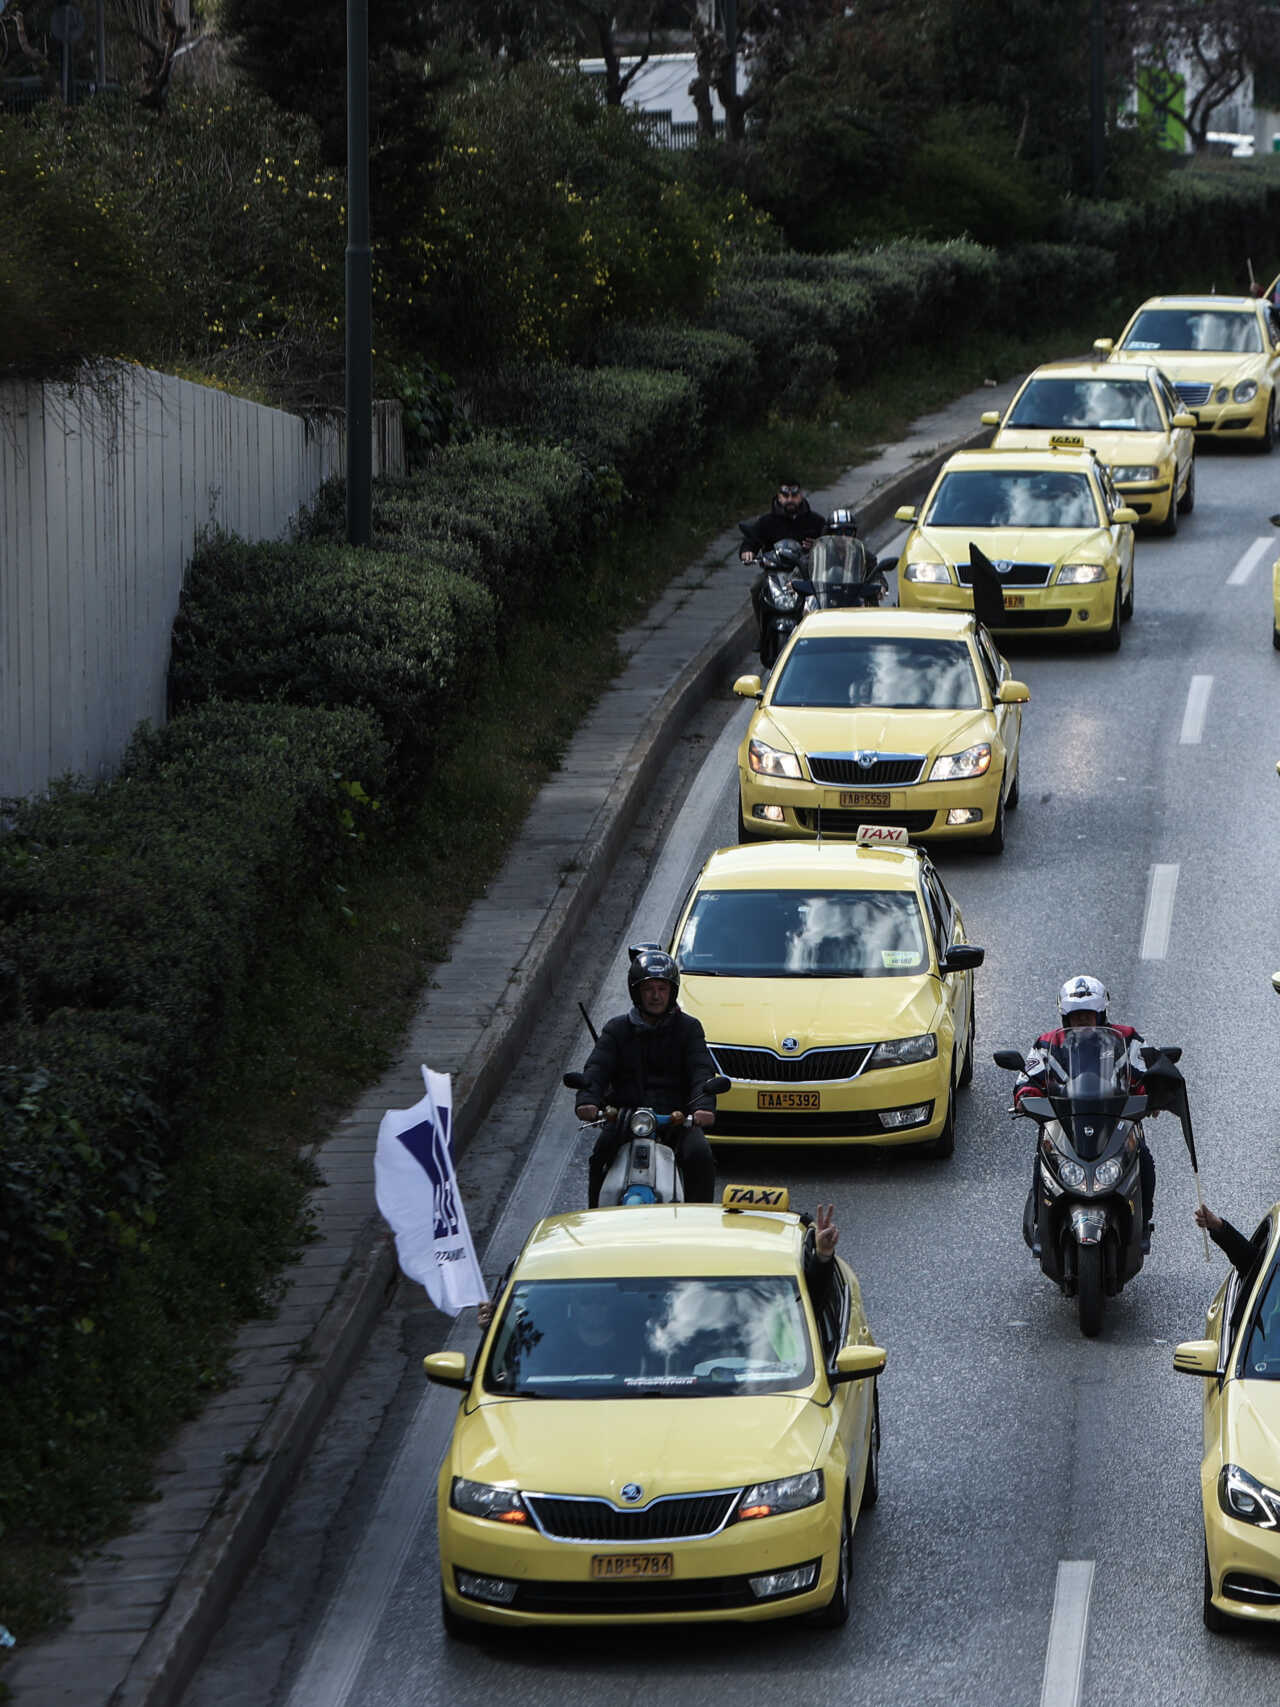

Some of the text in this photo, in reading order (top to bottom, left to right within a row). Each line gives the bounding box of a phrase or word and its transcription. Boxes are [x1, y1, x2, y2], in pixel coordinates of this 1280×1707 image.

[1051, 436, 1081, 445] TAXI
[861, 827, 904, 841] TAXI
[729, 1188, 784, 1206] TAXI
